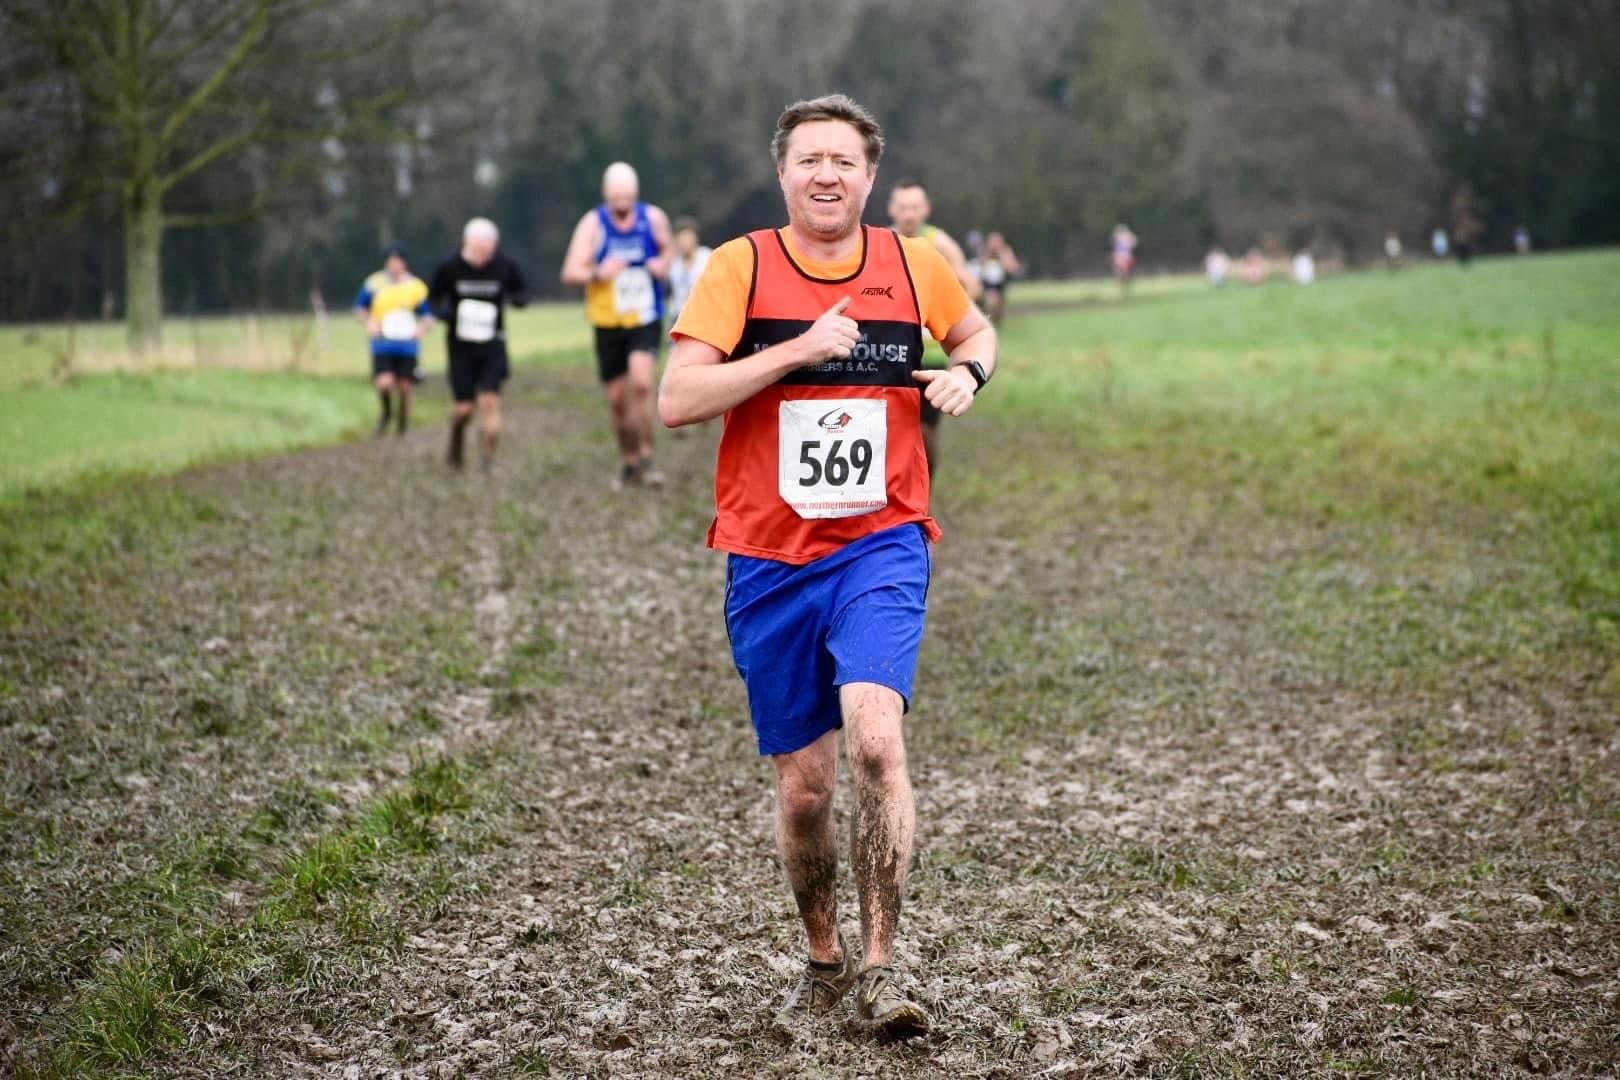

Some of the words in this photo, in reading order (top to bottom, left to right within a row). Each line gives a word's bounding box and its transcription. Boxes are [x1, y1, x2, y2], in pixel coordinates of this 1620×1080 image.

[846, 362, 854, 372] &
[856, 362, 879, 372] A.C.
[798, 438, 873, 487] 569
